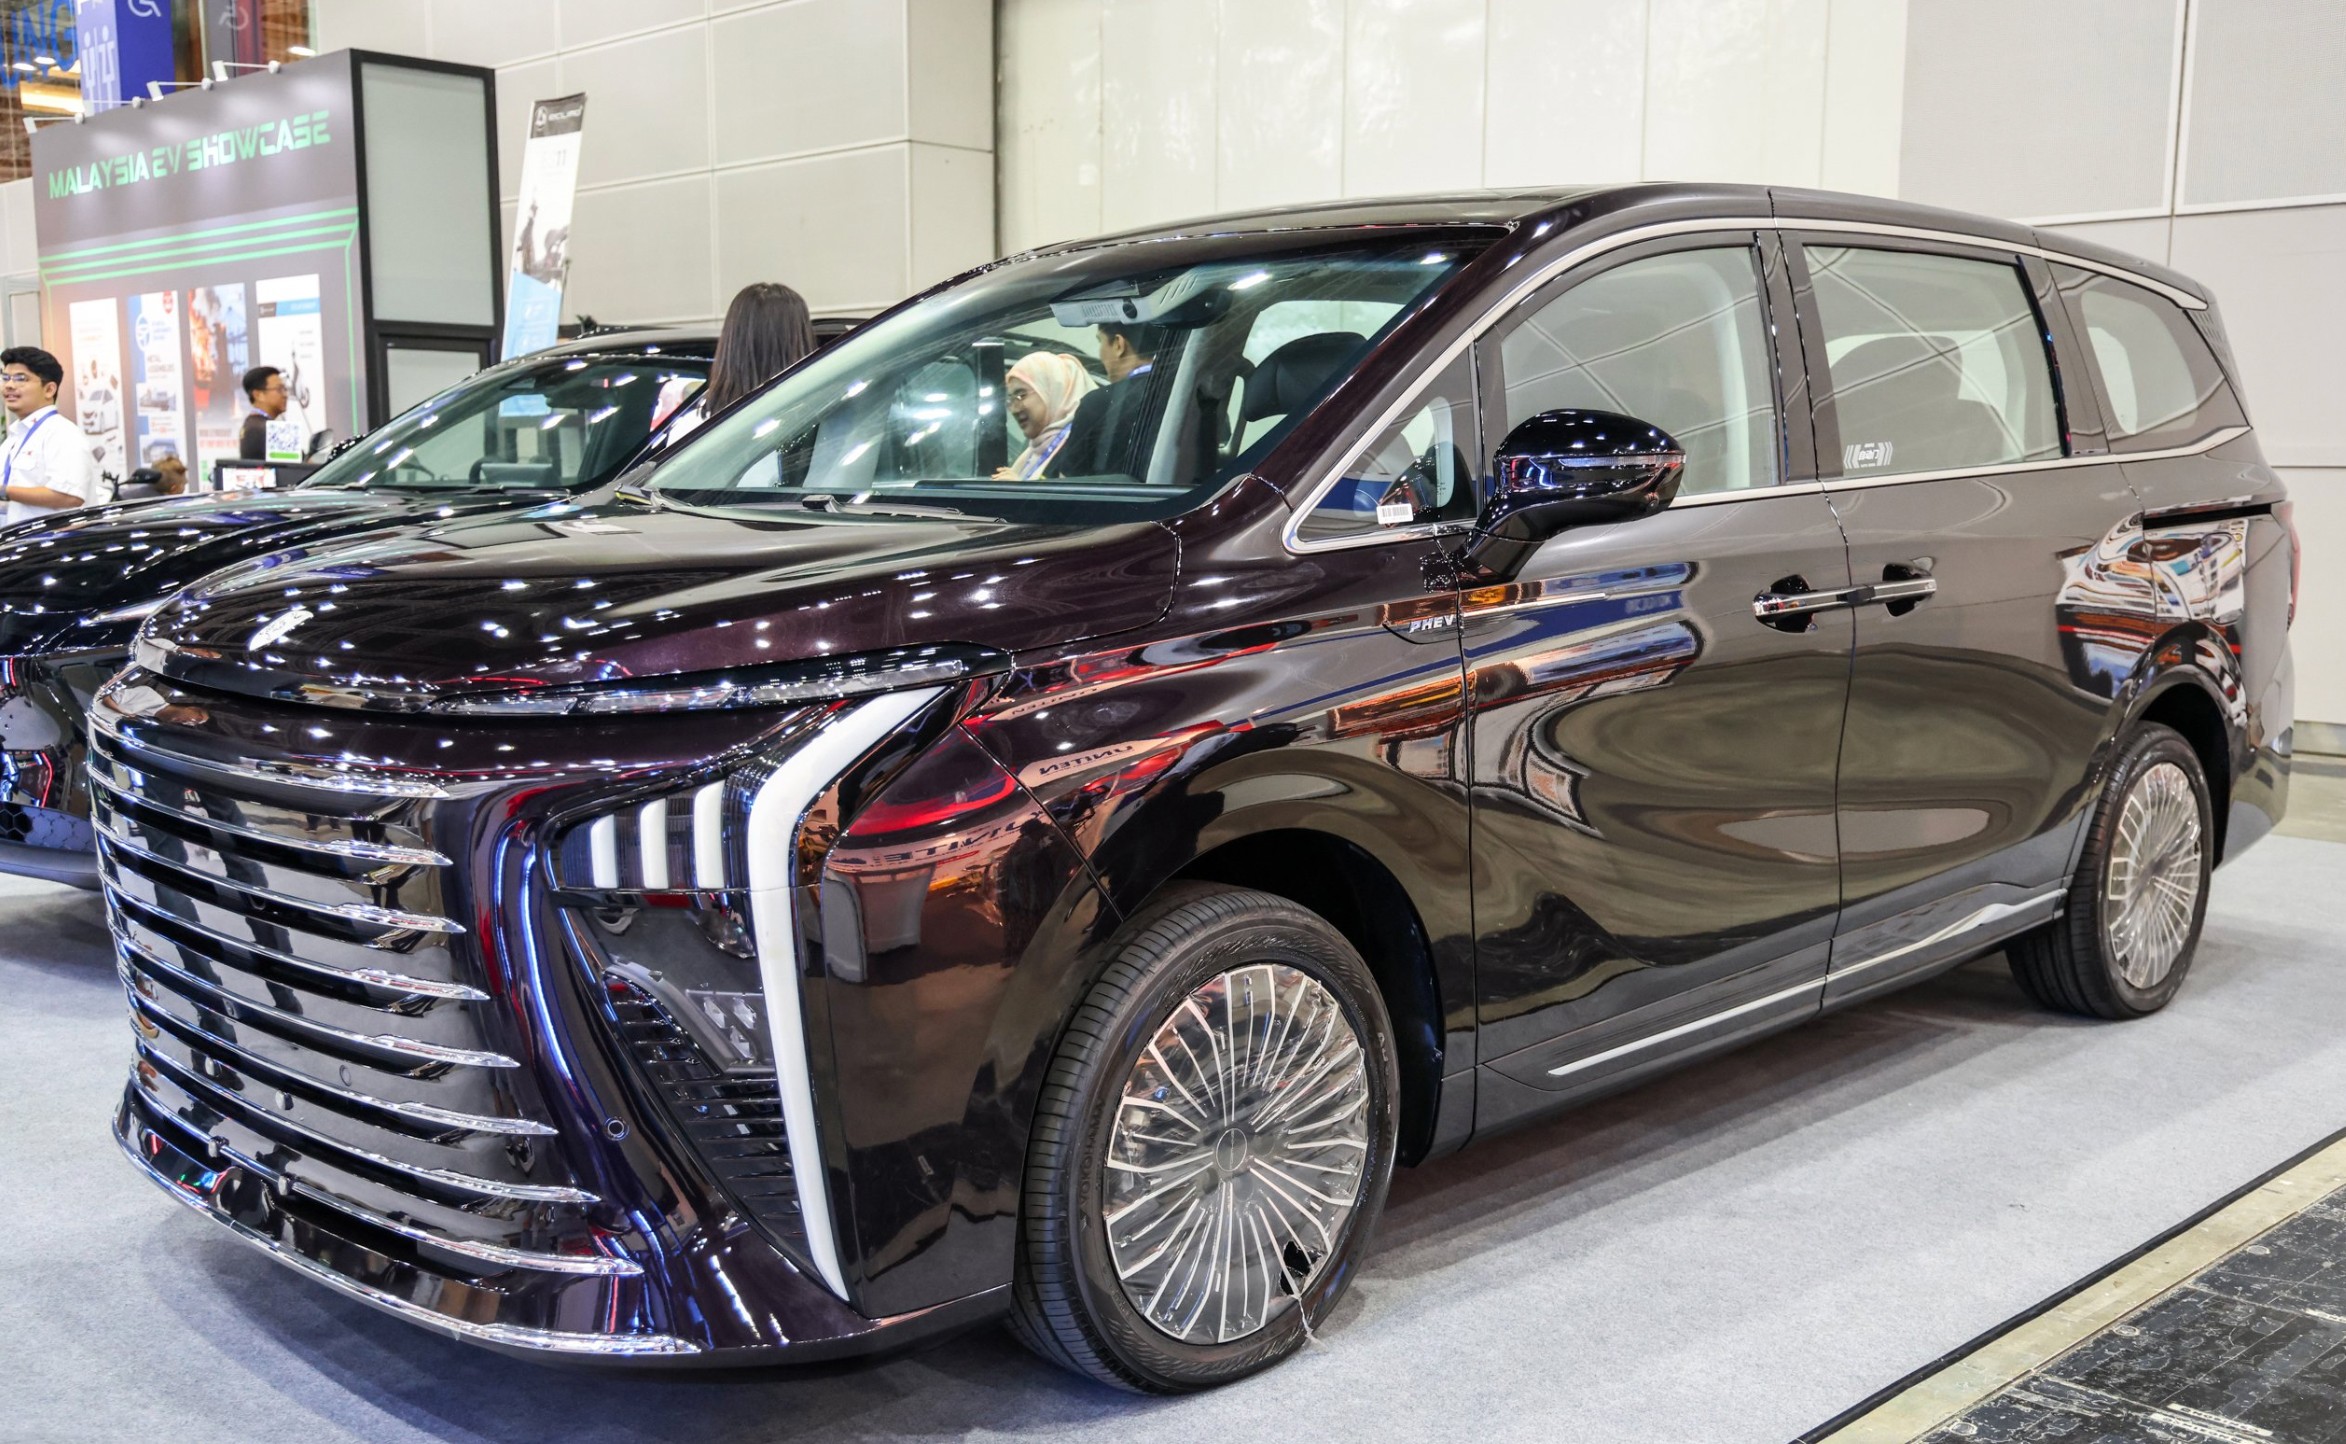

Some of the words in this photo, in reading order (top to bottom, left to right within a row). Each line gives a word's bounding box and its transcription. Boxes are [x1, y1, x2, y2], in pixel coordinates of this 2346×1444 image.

[48, 151, 150, 199] MALAYSIA
[151, 143, 183, 179] EV
[186, 109, 332, 171] SHOWCASE
[1408, 614, 1455, 634] PHEV
